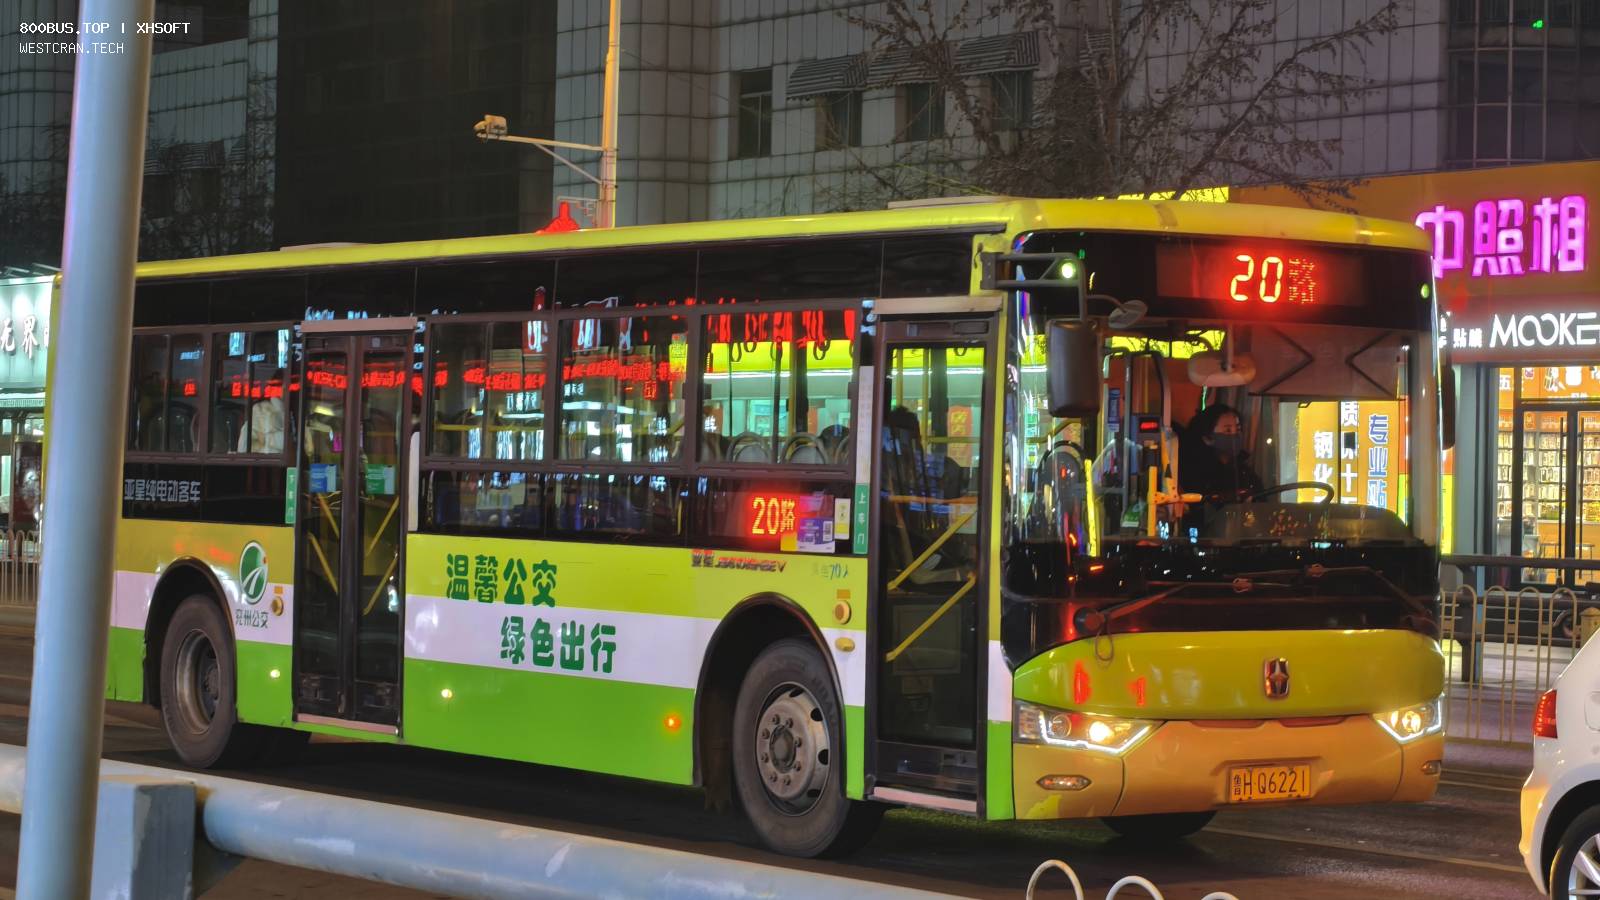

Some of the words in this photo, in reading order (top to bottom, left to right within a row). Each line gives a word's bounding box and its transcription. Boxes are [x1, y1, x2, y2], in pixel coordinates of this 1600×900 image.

[1230, 254, 1317, 305] 20路
[124, 478, 201, 503] 亚星纯电动客车
[751, 496, 796, 535] 20路
[446, 552, 558, 608] 温馨公交
[499, 615, 617, 674] 绿色出行
